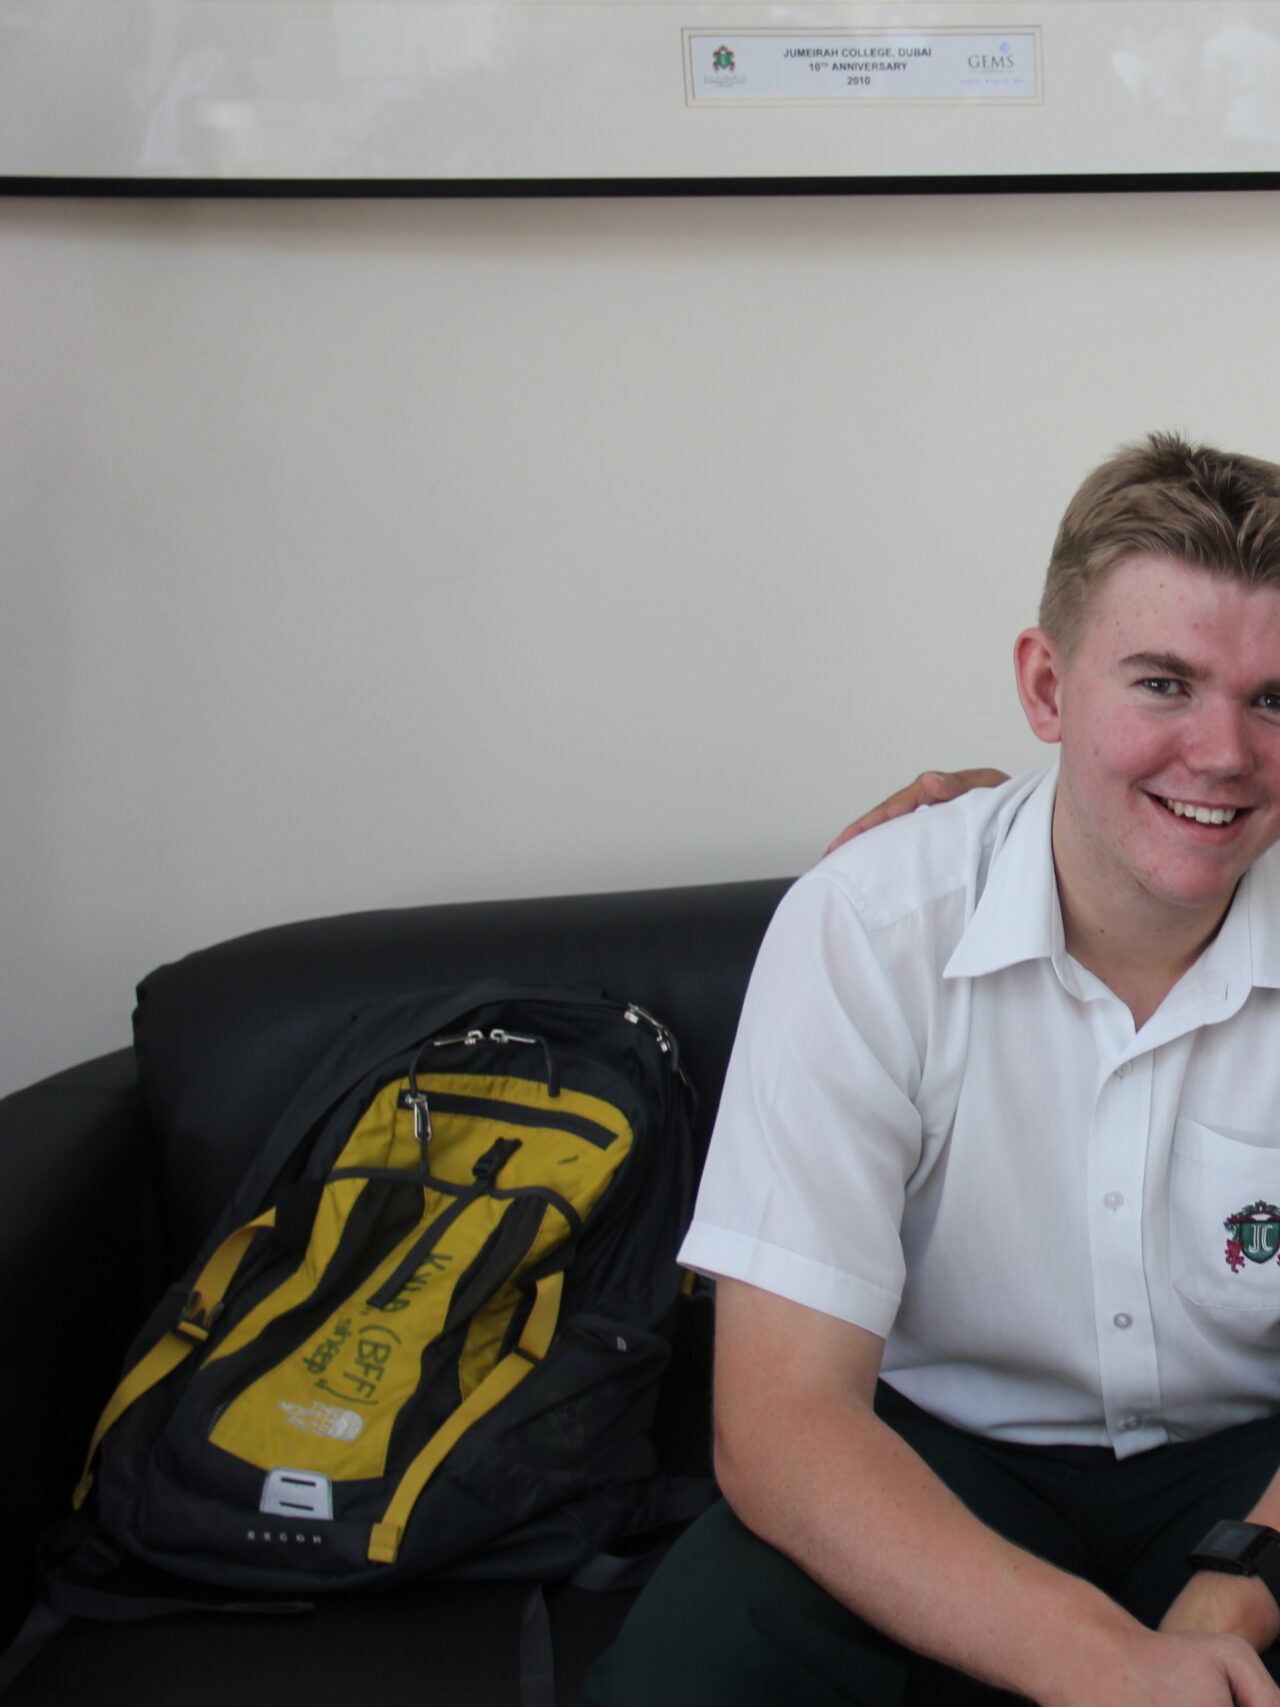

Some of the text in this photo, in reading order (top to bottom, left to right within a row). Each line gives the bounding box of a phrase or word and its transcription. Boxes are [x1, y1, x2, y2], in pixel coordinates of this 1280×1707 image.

[783, 47, 932, 59] JUMEIRAH COLLEGE, DUBAI
[809, 61, 908, 72] 10TH ANNIVERSARY
[967, 54, 1015, 69] GEMS
[847, 76, 871, 86] 2010
[1247, 1223, 1274, 1254] JC
